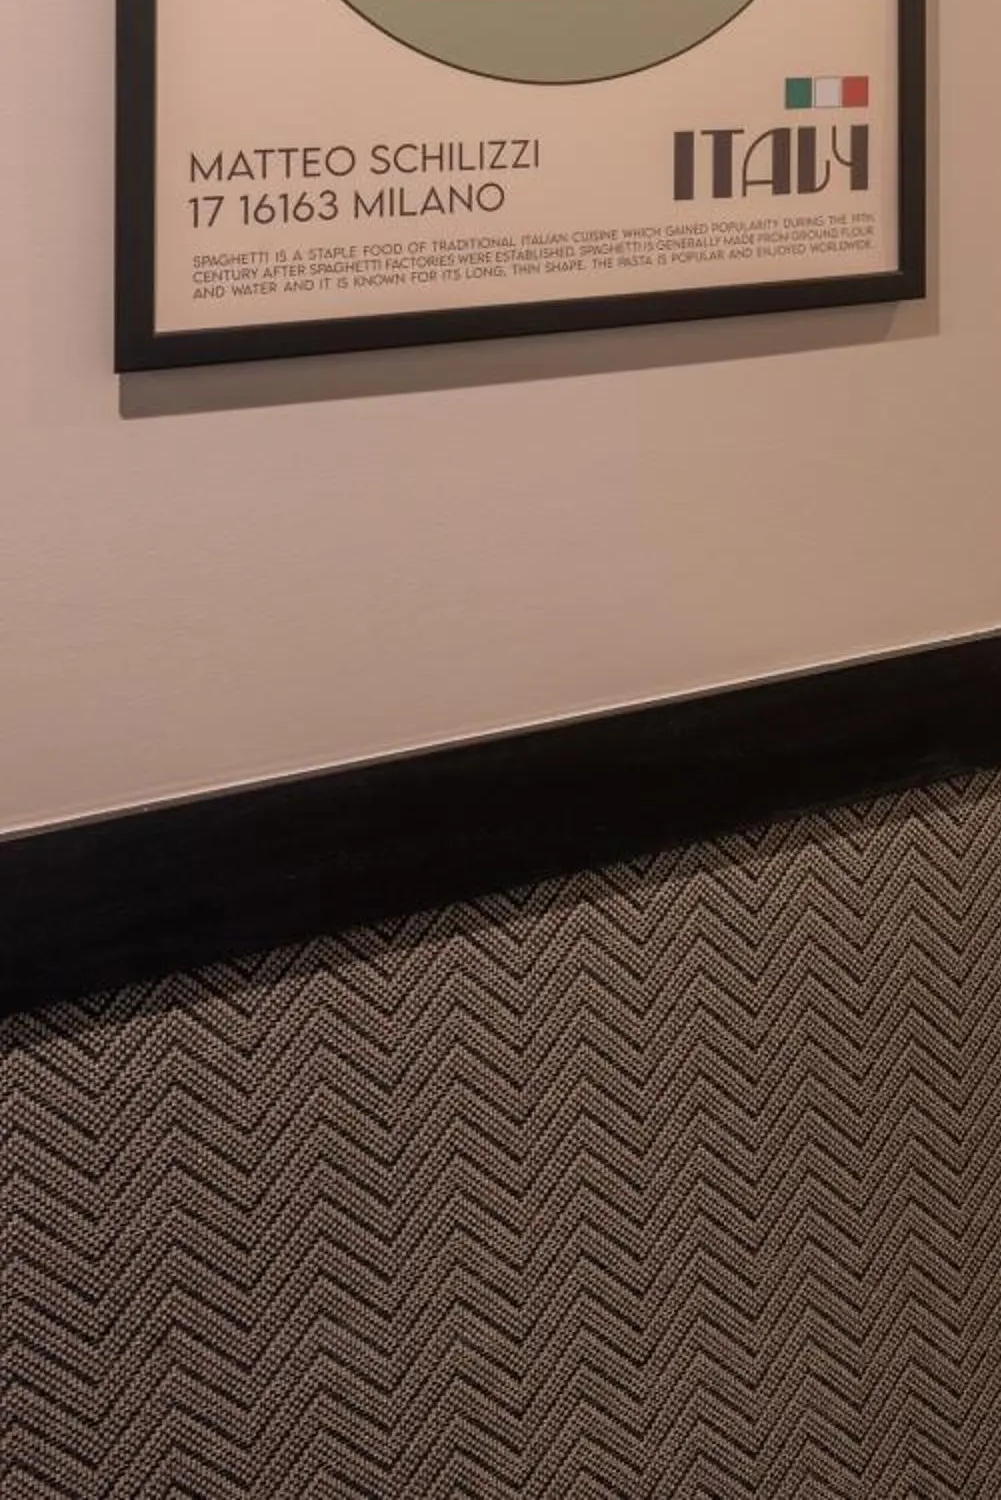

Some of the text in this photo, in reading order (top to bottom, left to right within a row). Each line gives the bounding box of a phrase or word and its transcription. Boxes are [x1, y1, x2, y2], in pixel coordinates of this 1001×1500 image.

[189, 139, 541, 183] MATTEO SCHILIZZI
[673, 124, 869, 201] ITALY
[188, 182, 506, 229] 17 16163 MILANO
[192, 251, 269, 268] SPAGHETTI
[275, 251, 288, 263] IS
[292, 250, 305, 262] A
[308, 246, 357, 261] STAPLE
[363, 243, 403, 257] FOOD
[407, 241, 428, 254] OF
[431, 237, 516, 251] TRADITIONAL
[520, 232, 568, 246] ITALIAN
[571, 229, 618, 243] CUISINE
[621, 227, 662, 239] WHICH
[665, 223, 709, 237] GAINED
[711, 219, 779, 234] POPULARITY
[783, 216, 825, 229] DURING
[192, 268, 259, 284] CENTURY
[263, 264, 306, 280] AFTER
[309, 260, 382, 276] SPAGHETTI
[385, 253, 455, 270] FACTORIES
[457, 251, 494, 265] WERE
[656, 237, 720, 251] GENERALLY
[723, 234, 755, 247] MADE
[757, 231, 790, 244] FROM
[791, 227, 839, 242] GROUND
[192, 285, 225, 300] AND
[231, 281, 278, 296] WATER
[283, 278, 315, 293] AND
[319, 278, 333, 291] IT
[337, 277, 349, 289] IS
[353, 273, 406, 287] KNOWN
[411, 270, 437, 284] FOR
[441, 268, 461, 282] ITS
[512, 263, 541, 276] THIN
[591, 256, 614, 269] THE
[617, 255, 653, 267] PASTA
[656, 254, 668, 266] IS
[671, 250, 725, 264] POPULAR
[728, 248, 753, 261] AND
[756, 243, 809, 259] ENJOYED
